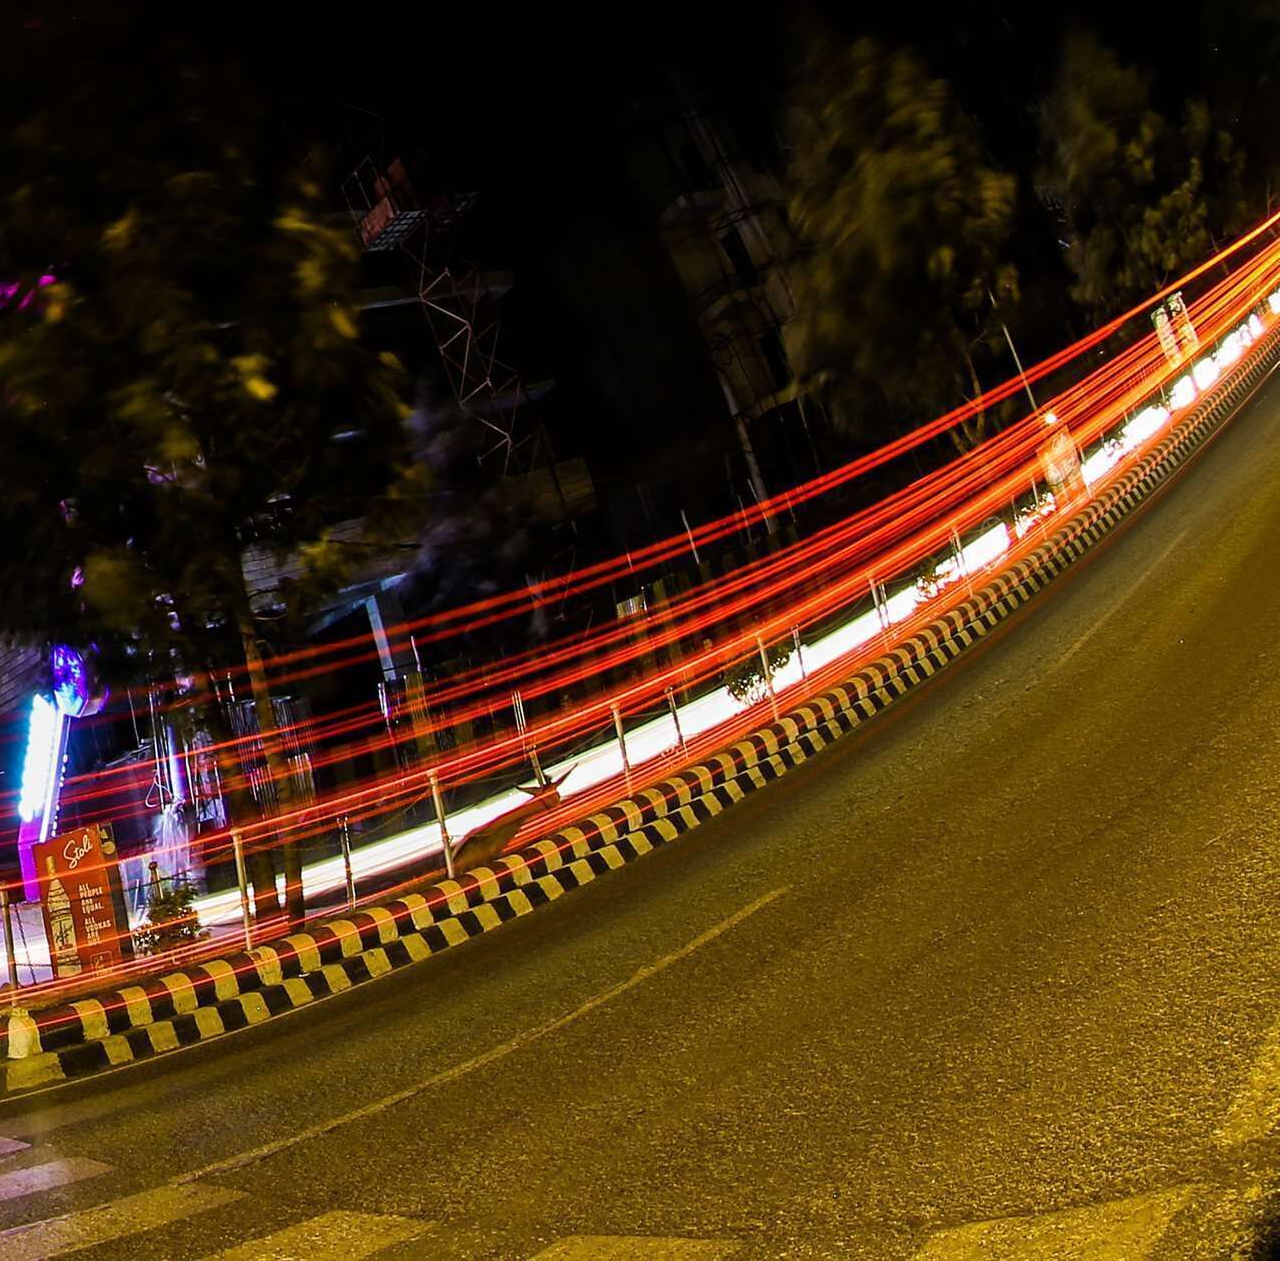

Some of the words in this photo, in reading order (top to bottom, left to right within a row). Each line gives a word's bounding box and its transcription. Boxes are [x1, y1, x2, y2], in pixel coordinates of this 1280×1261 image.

[63, 834, 93, 869] Stoli
[79, 883, 90, 891] ALL
[79, 886, 103, 899] PEOPLE
[84, 917, 96, 925] ALL
[85, 920, 111, 932] VODKAS
